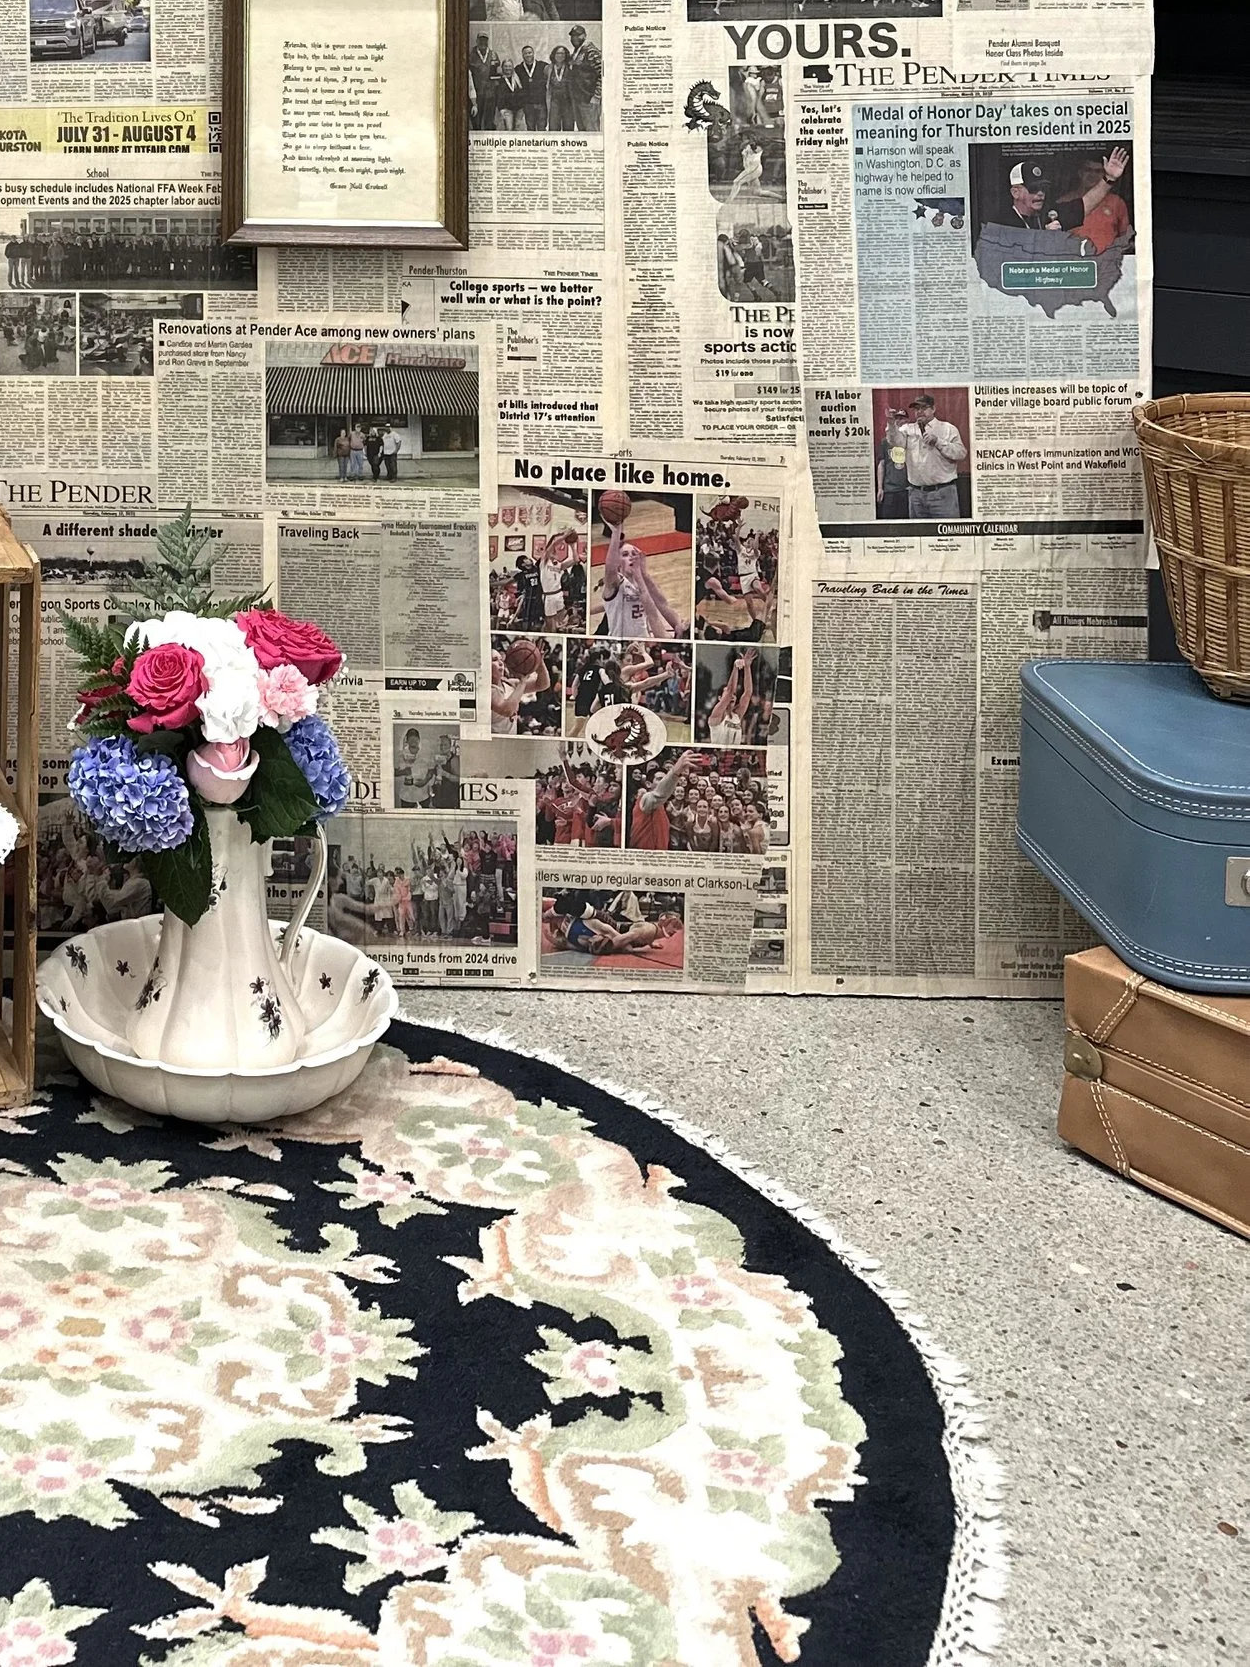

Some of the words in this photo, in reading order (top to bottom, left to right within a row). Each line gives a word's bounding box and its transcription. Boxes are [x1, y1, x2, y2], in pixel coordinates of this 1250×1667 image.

[725, 22, 911, 60] YOURS.
[908, 105, 924, 120] of
[927, 105, 972, 120] Honor
[1010, 103, 1050, 118] takes
[1053, 105, 1073, 117] on
[1076, 101, 1128, 119] special
[56, 126, 89, 143] JULY
[92, 126, 110, 143] 31
[121, 126, 184, 143] AUGUST
[185, 126, 197, 142] 4
[855, 125, 918, 142] meaning
[921, 123, 943, 138] for
[945, 123, 1012, 138] Thurston
[1016, 121, 1075, 136] resident
[1079, 120, 1092, 135] in
[1096, 120, 1131, 135] 2025
[1041, 266, 1061, 274] Medal
[1035, 276, 1064, 285] Highway
[514, 459, 543, 479] No
[551, 461, 607, 485] place
[614, 463, 655, 484] like
[663, 465, 731, 488] home.
